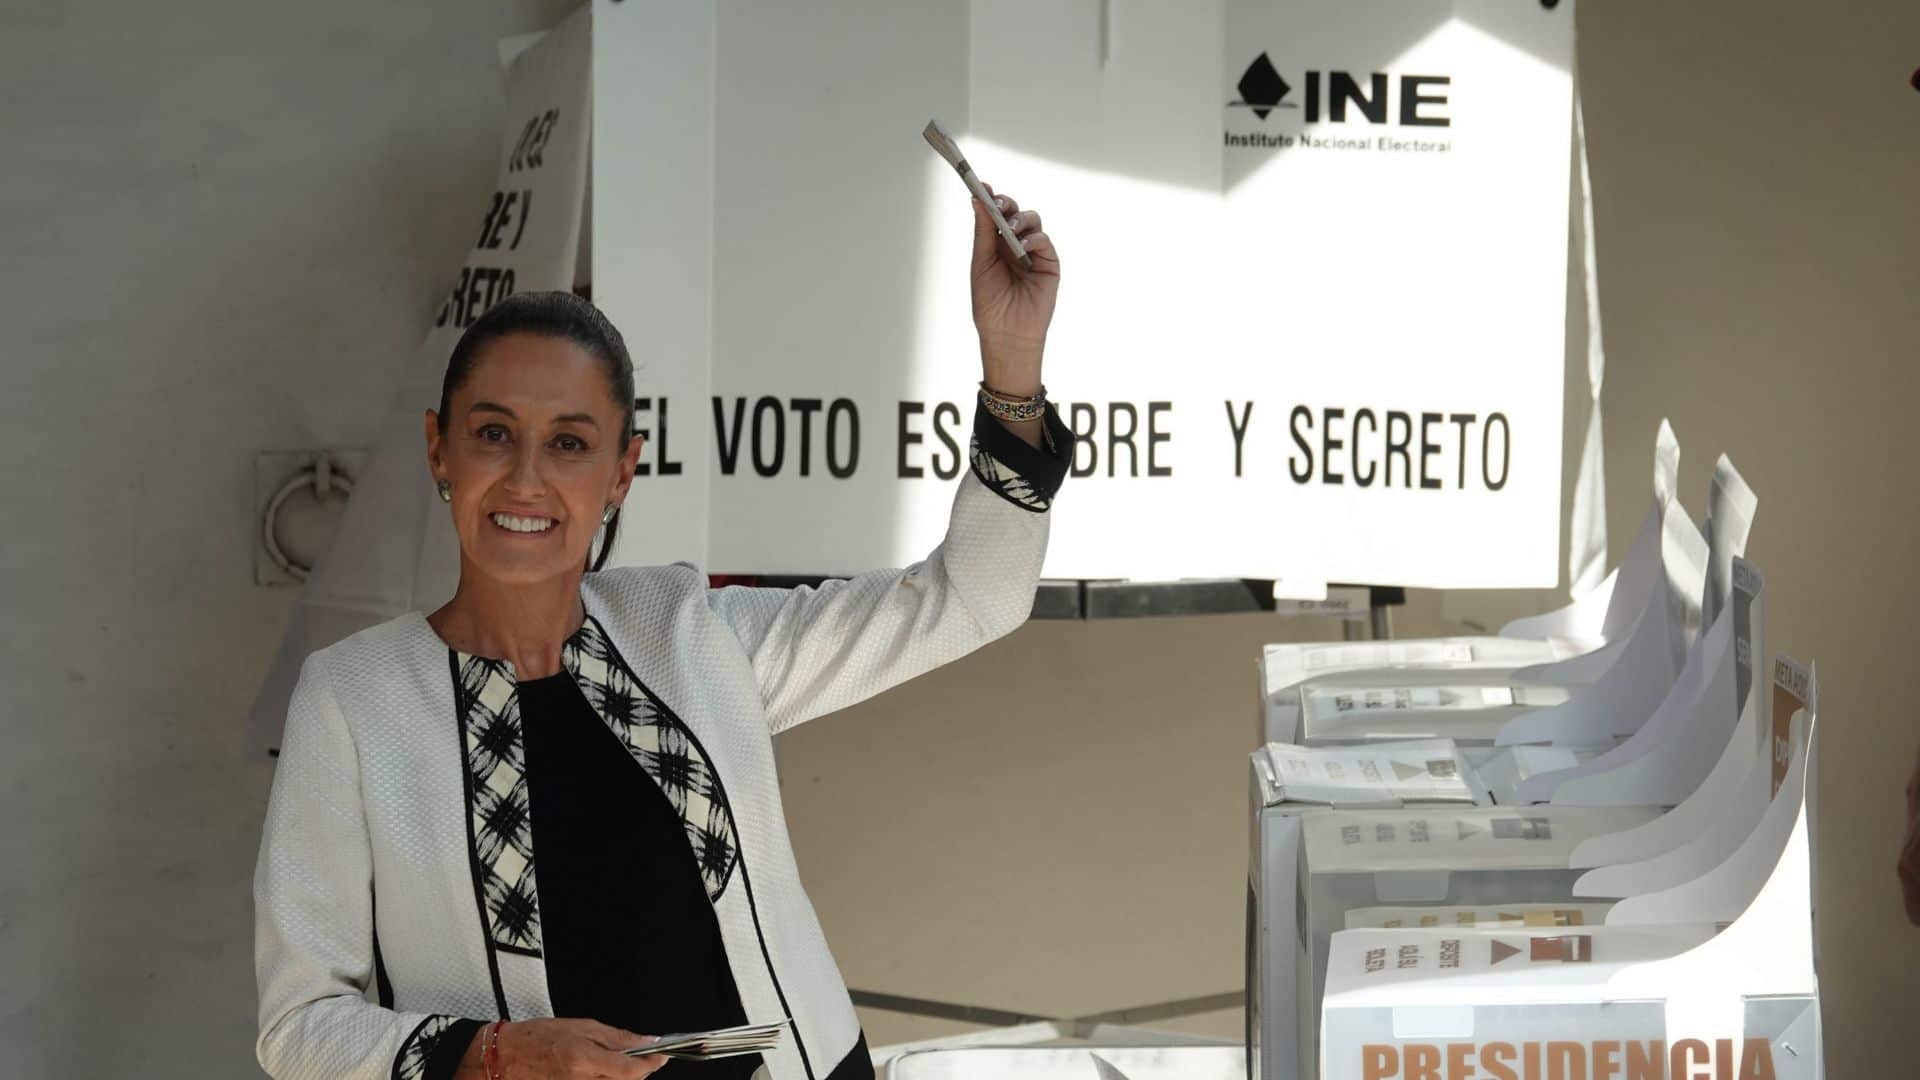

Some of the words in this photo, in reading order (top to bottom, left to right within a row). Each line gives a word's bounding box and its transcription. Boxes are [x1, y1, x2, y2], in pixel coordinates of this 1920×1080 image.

[1305, 71, 1450, 127] INE
[1224, 131, 1294, 148] Instituto
[1301, 133, 1371, 150] Nacional
[1378, 137, 1451, 153] Electoral
[633, 397, 682, 475] EL
[712, 396, 860, 479] VOTO
[897, 400, 962, 480] ES
[1054, 401, 1173, 478] BRE
[1224, 400, 1254, 477] Y
[1289, 404, 1511, 491] SECRETO
[1362, 1038, 1778, 1080] PRESIDENCIA
